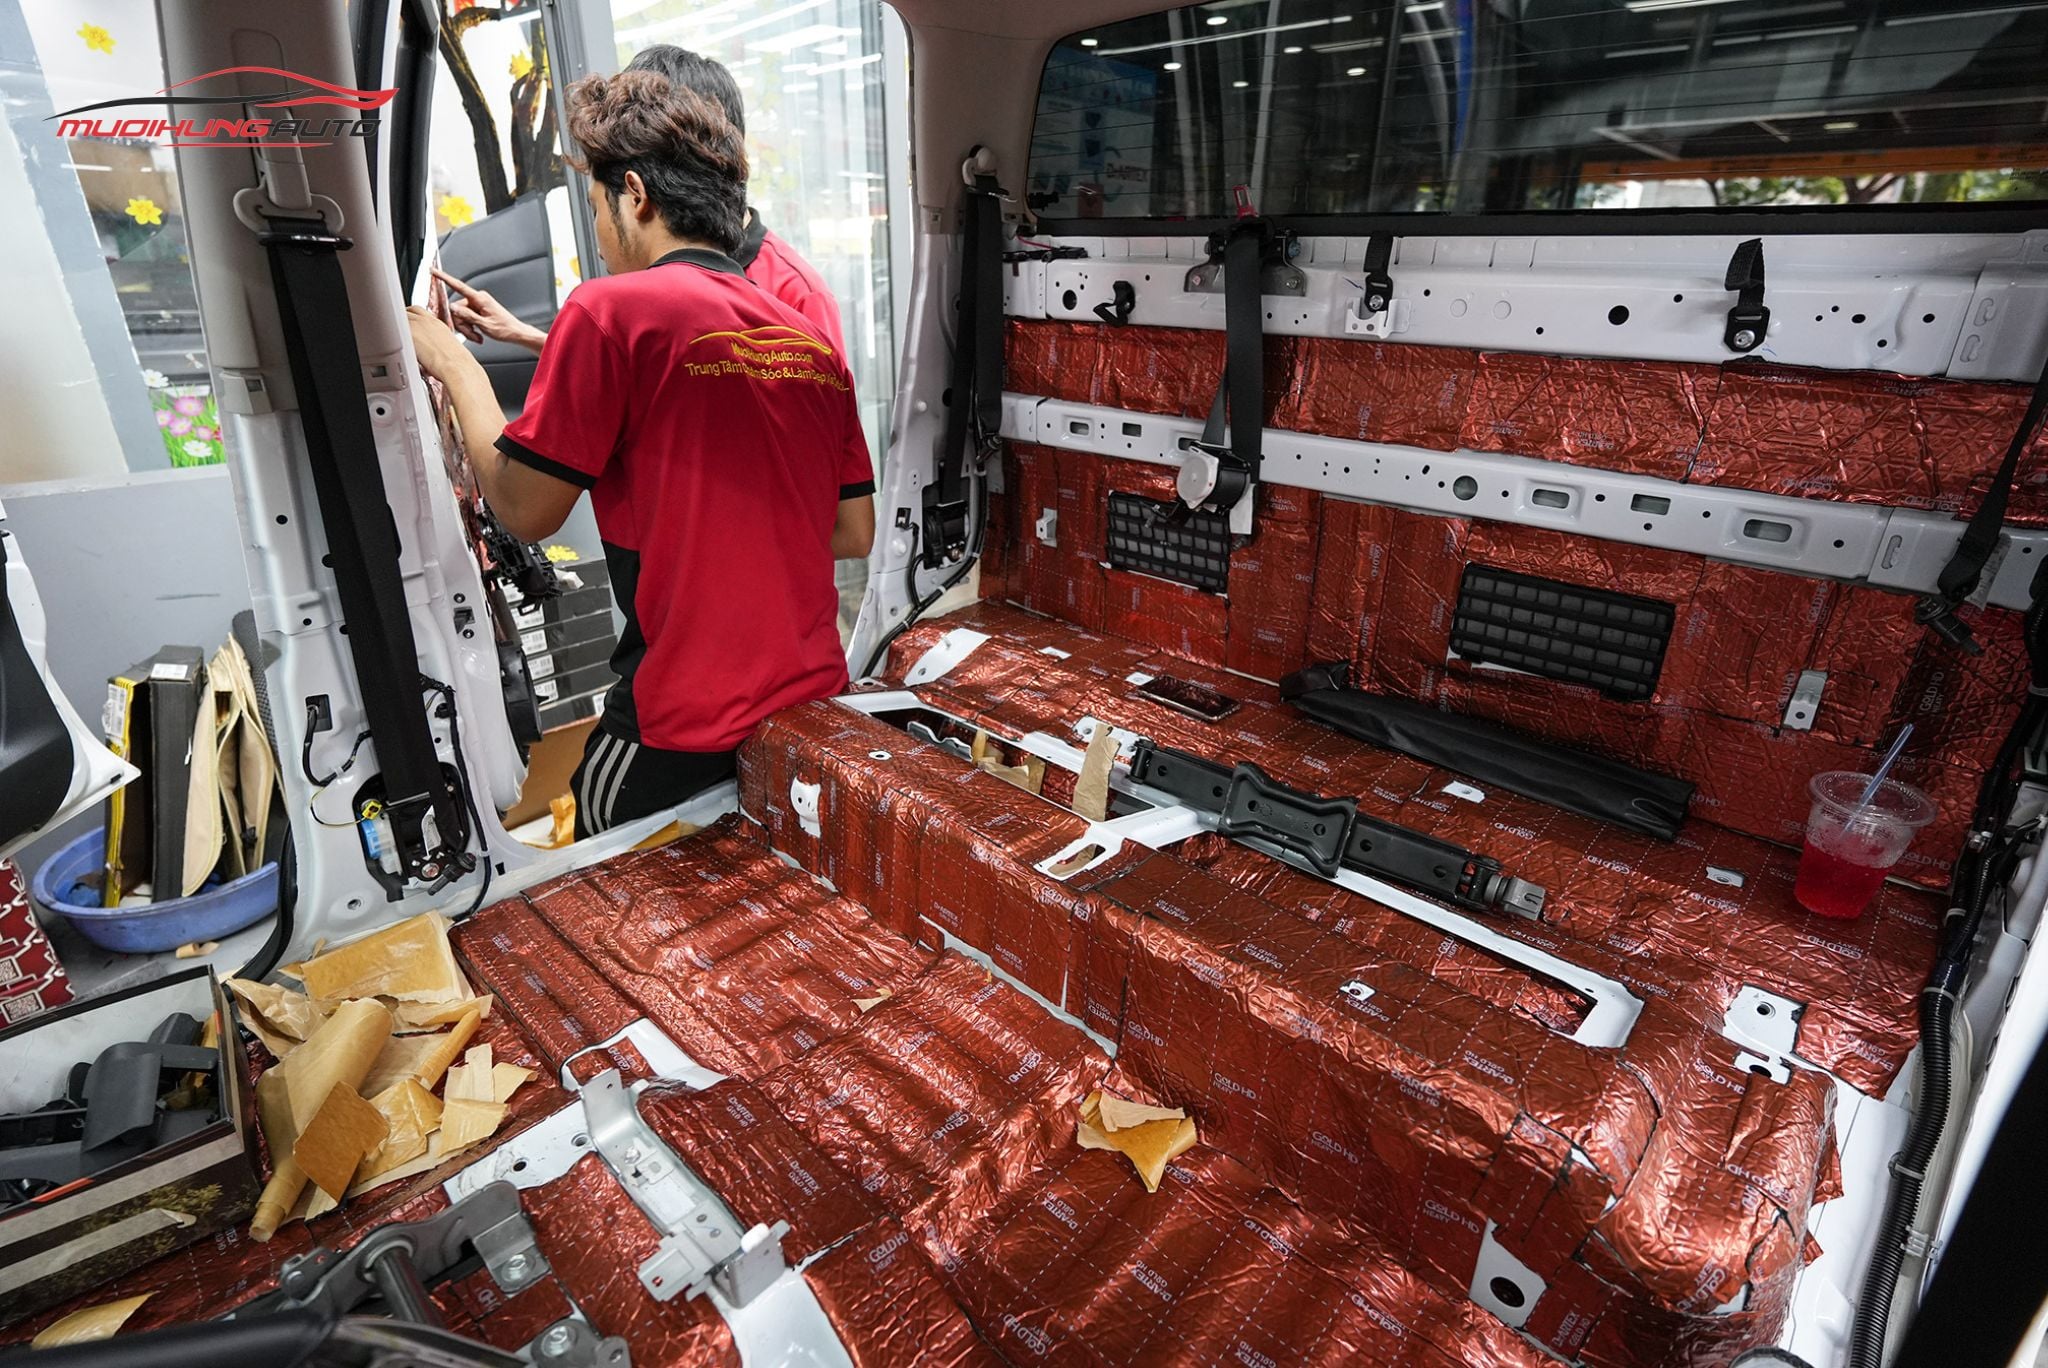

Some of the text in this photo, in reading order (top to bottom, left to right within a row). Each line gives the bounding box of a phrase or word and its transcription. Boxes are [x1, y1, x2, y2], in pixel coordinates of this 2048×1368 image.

[1920, 672, 1945, 712] GOLD HD
[1932, 695, 1945, 714] HEAVY
[1507, 827, 1536, 840] GOLD
[1601, 859, 1630, 875] GOLD
[1042, 886, 1062, 904] GOLD
[1708, 897, 1738, 914] GOLD
[1156, 902, 1191, 923] DrARTEX
[784, 930, 810, 952] GOLD HD
[1525, 935, 1559, 951] GOLD
[1607, 939, 1650, 958] DrARTEX
[1826, 942, 1862, 960] GOLD
[1243, 948, 1283, 970] DrARTEX
[1260, 948, 1278, 960] GOLD
[836, 970, 863, 991] GOLD HD
[1618, 973, 1669, 997] GOLD HD
[1088, 1004, 1118, 1025] DrARTEX
[1346, 999, 1390, 1022] DrARTEX
[1127, 1027, 1145, 1042] HEAVY
[1128, 1021, 1164, 1047] GOLD HD
[615, 1055, 630, 1072] GOLD
[1009, 1052, 1042, 1083] GOLD HD
[1462, 1056, 1515, 1086] DrARTEX
[1480, 1059, 1505, 1072] GOLD
[1214, 1072, 1257, 1100] GOLD HD
[1391, 1070, 1441, 1099] DrARTEX
[1696, 1058, 1746, 1095] GOLD HD
[1213, 1081, 1233, 1095] HEAVY
[1400, 1084, 1422, 1100] GOLD
[726, 1105, 741, 1119] GOLD
[728, 1094, 757, 1124] DrARTEX
[932, 1112, 969, 1140] GOLD HD
[1311, 1138, 1335, 1154] HEAVY
[1312, 1131, 1358, 1164] GOLD HD
[788, 1172, 805, 1189] GOLD
[789, 1160, 820, 1192] DrARTEX
[1165, 1164, 1191, 1184] GOLD
[1726, 1163, 1749, 1179] HD
[1750, 1175, 1791, 1203] GOLD
[1042, 1199, 1078, 1230] DrARTEX
[1057, 1200, 1075, 1217] GOLD
[1423, 1209, 1450, 1223] HEAVY
[1424, 1200, 1480, 1234] GOLD HD
[869, 1231, 909, 1265] GOLD HD
[1244, 1220, 1289, 1256] GOLD HD
[874, 1252, 898, 1273] HEAVY
[1698, 1258, 1719, 1284] HEAVY
[1131, 1267, 1172, 1302] DrARTEX
[1149, 1269, 1167, 1287] GOLD
[1678, 1269, 1726, 1309] GOLD HD
[1351, 1294, 1402, 1336] GOLD HD
[1003, 1313, 1046, 1355] GOLD HD
[1030, 1325, 1053, 1345] HEAVY
[1552, 1311, 1579, 1349] DrARTEX
[1569, 1330, 1584, 1348] GOLD
[1253, 1351, 1276, 1368] GOLD
